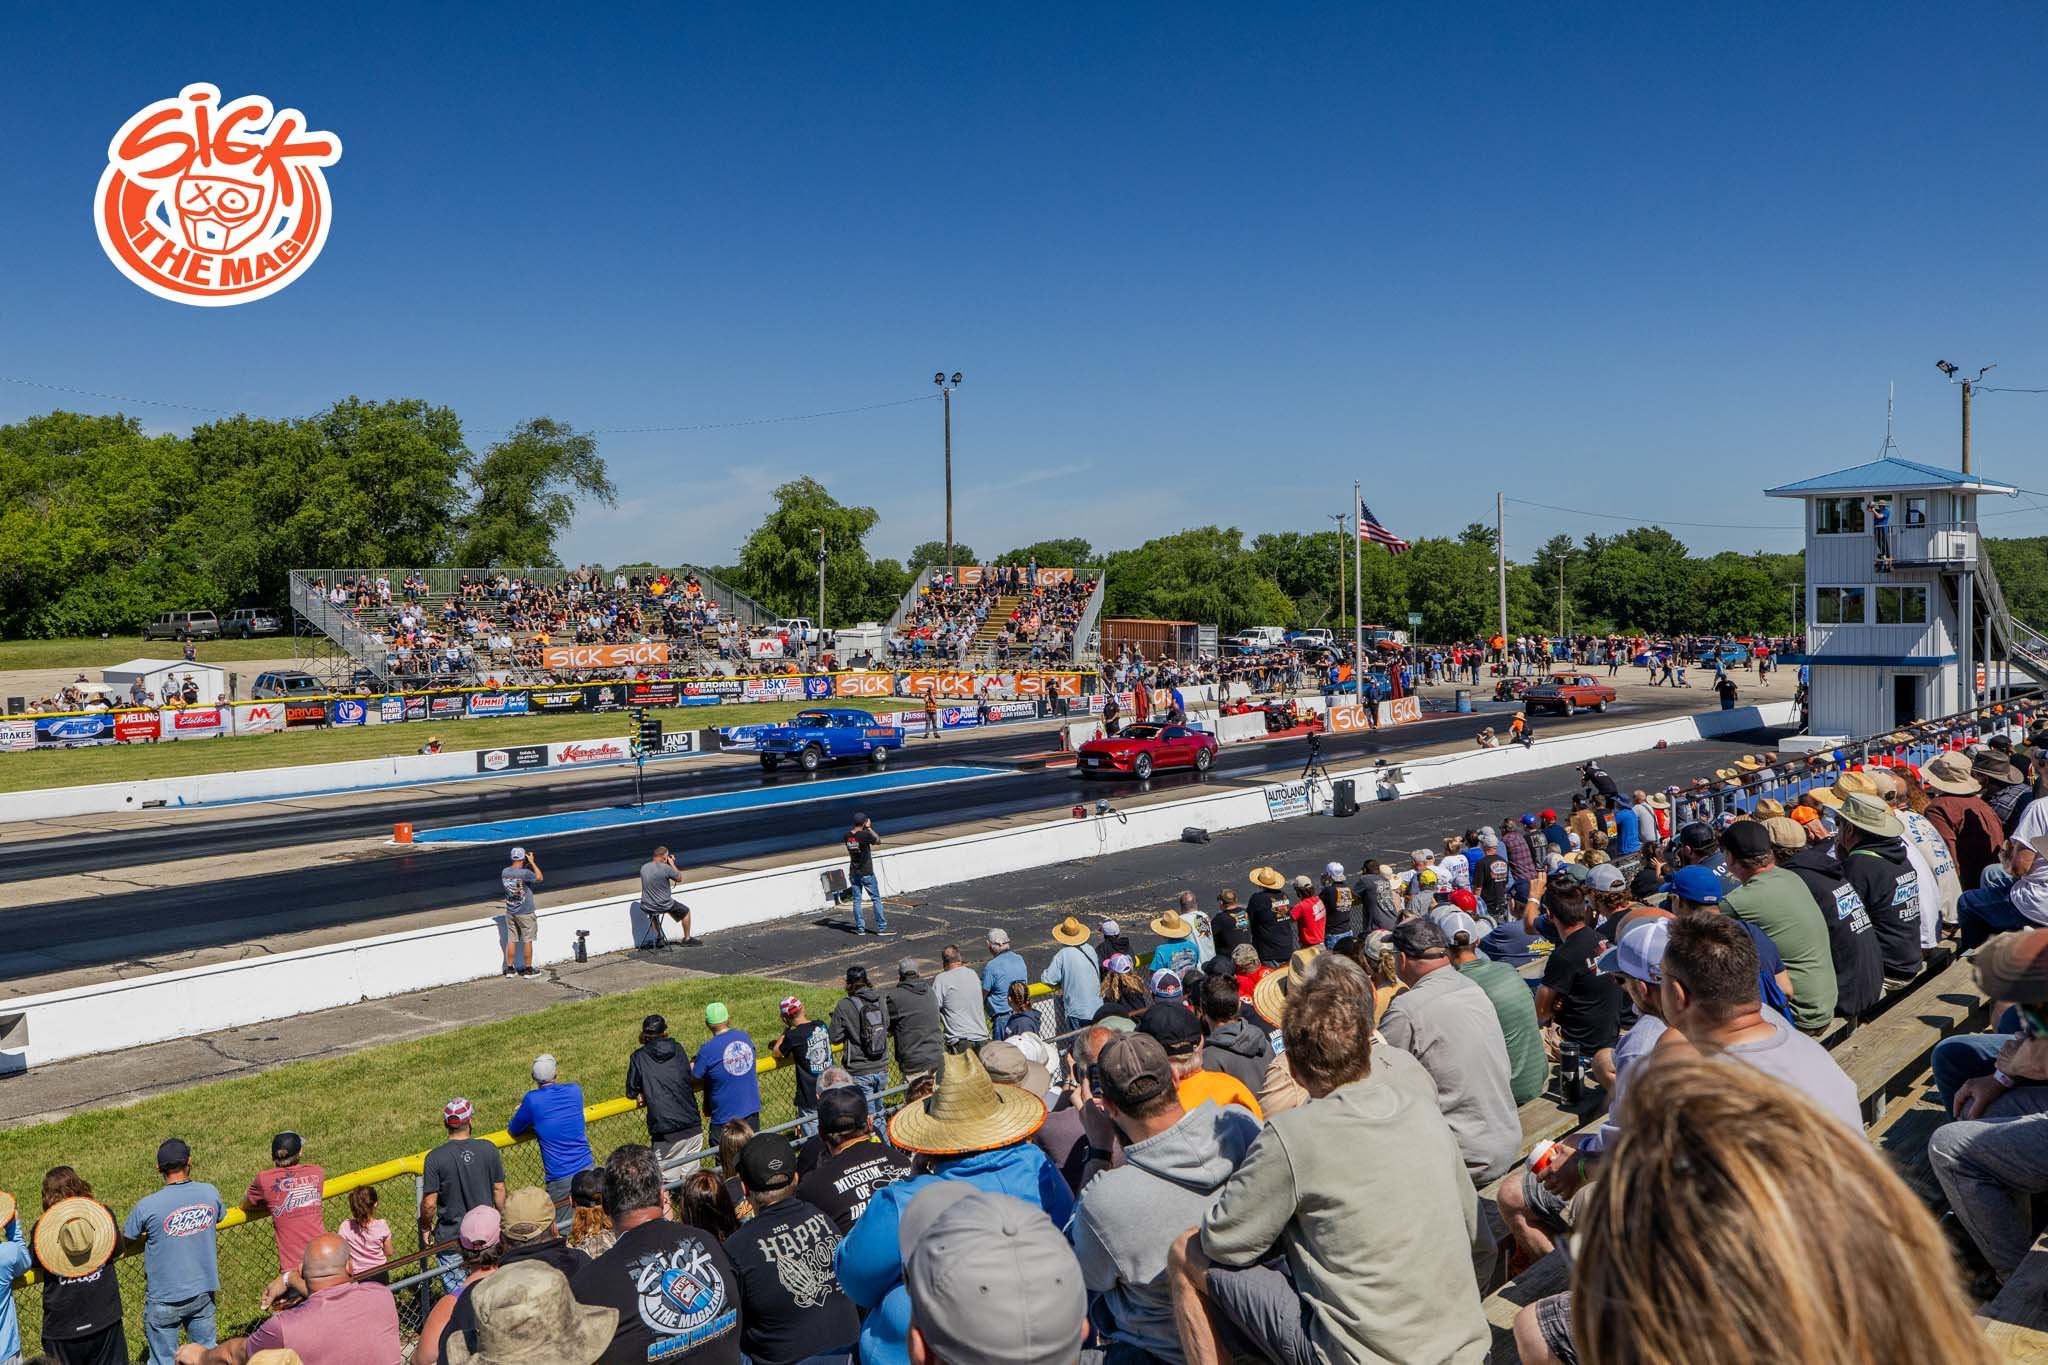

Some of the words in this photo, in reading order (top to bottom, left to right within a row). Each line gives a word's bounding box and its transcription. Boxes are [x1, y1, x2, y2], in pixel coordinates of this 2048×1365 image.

[687, 681, 739, 689] OVERDRIVE
[764, 680, 787, 690] ISKY
[749, 688, 778, 696] RACING
[780, 687, 800, 695] CAMS
[471, 694, 506, 710] SUMMIT
[991, 703, 1033, 713] OVERDRIVE
[120, 712, 159, 724] MELLING
[287, 708, 324, 717] DRIVEN
[180, 715, 216, 724] Edelbrock
[0, 731, 32, 740] BRAKES
[661, 733, 689, 747] LAND
[1268, 785, 1306, 801] AUTOLAND
[843, 1165, 860, 1175] DON
[833, 1165, 883, 1194] MUSEUM
[855, 1184, 871, 1200] OF
[850, 1199, 871, 1220] DR
[172, 1208, 208, 1224] BYRON
[772, 1223, 789, 1234] 2025
[757, 1213, 832, 1262] HAPPY
[652, 1304, 680, 1327] THE
[678, 1281, 721, 1327] MAGAZINE
